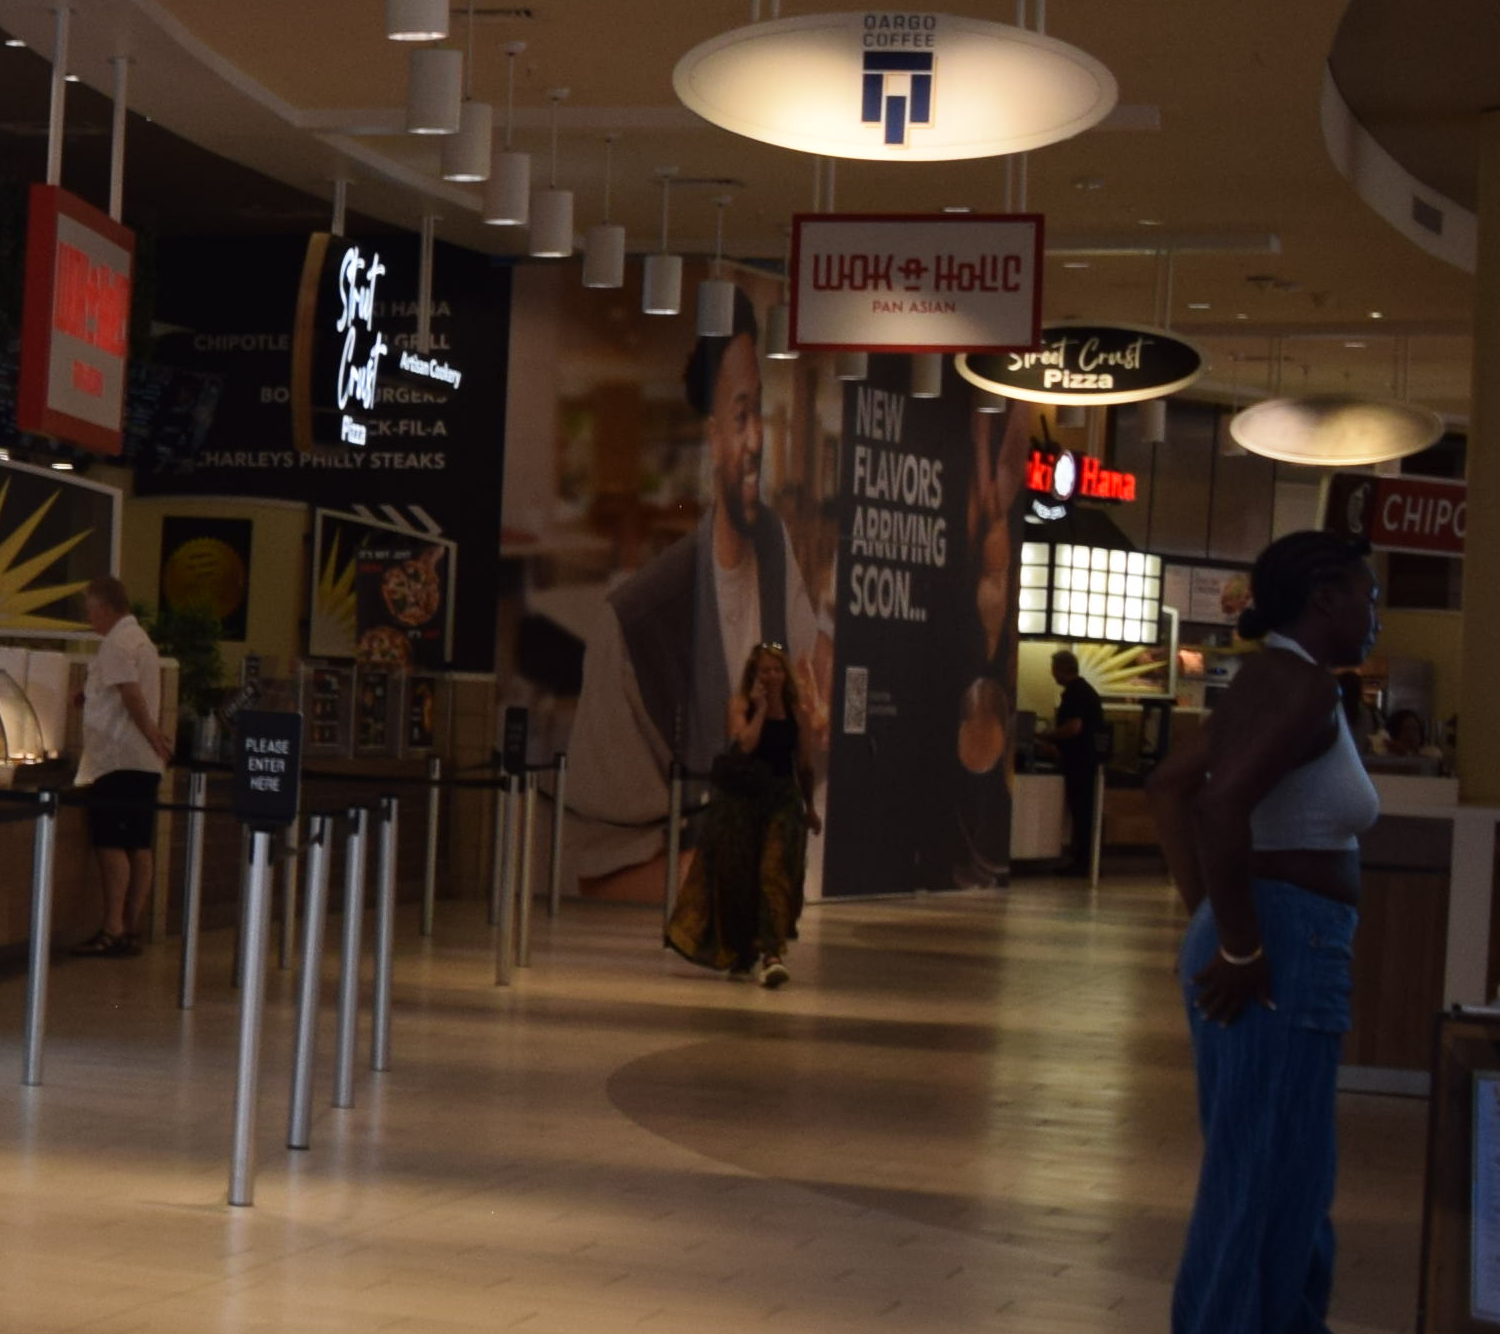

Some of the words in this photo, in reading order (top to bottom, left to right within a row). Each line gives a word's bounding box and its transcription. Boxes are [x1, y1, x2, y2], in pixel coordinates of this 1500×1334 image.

[864, 14, 936, 31] QARGO
[863, 33, 935, 48] COFFEE
[872, 300, 903, 314] PAN
[907, 300, 957, 315] ASIAN
[193, 333, 293, 352] CHIPOTLE
[1079, 338, 1156, 372] Crust
[1043, 369, 1115, 390] Pizza
[855, 385, 905, 444] NEW
[369, 451, 447, 470] STEAKS
[852, 443, 944, 510] FLAVORS
[1080, 455, 1137, 502] Hana
[850, 503, 947, 568] ARRIVING
[245, 737, 292, 755] PLEASE
[247, 756, 286, 774] ENTER
[249, 775, 281, 793] HERE
